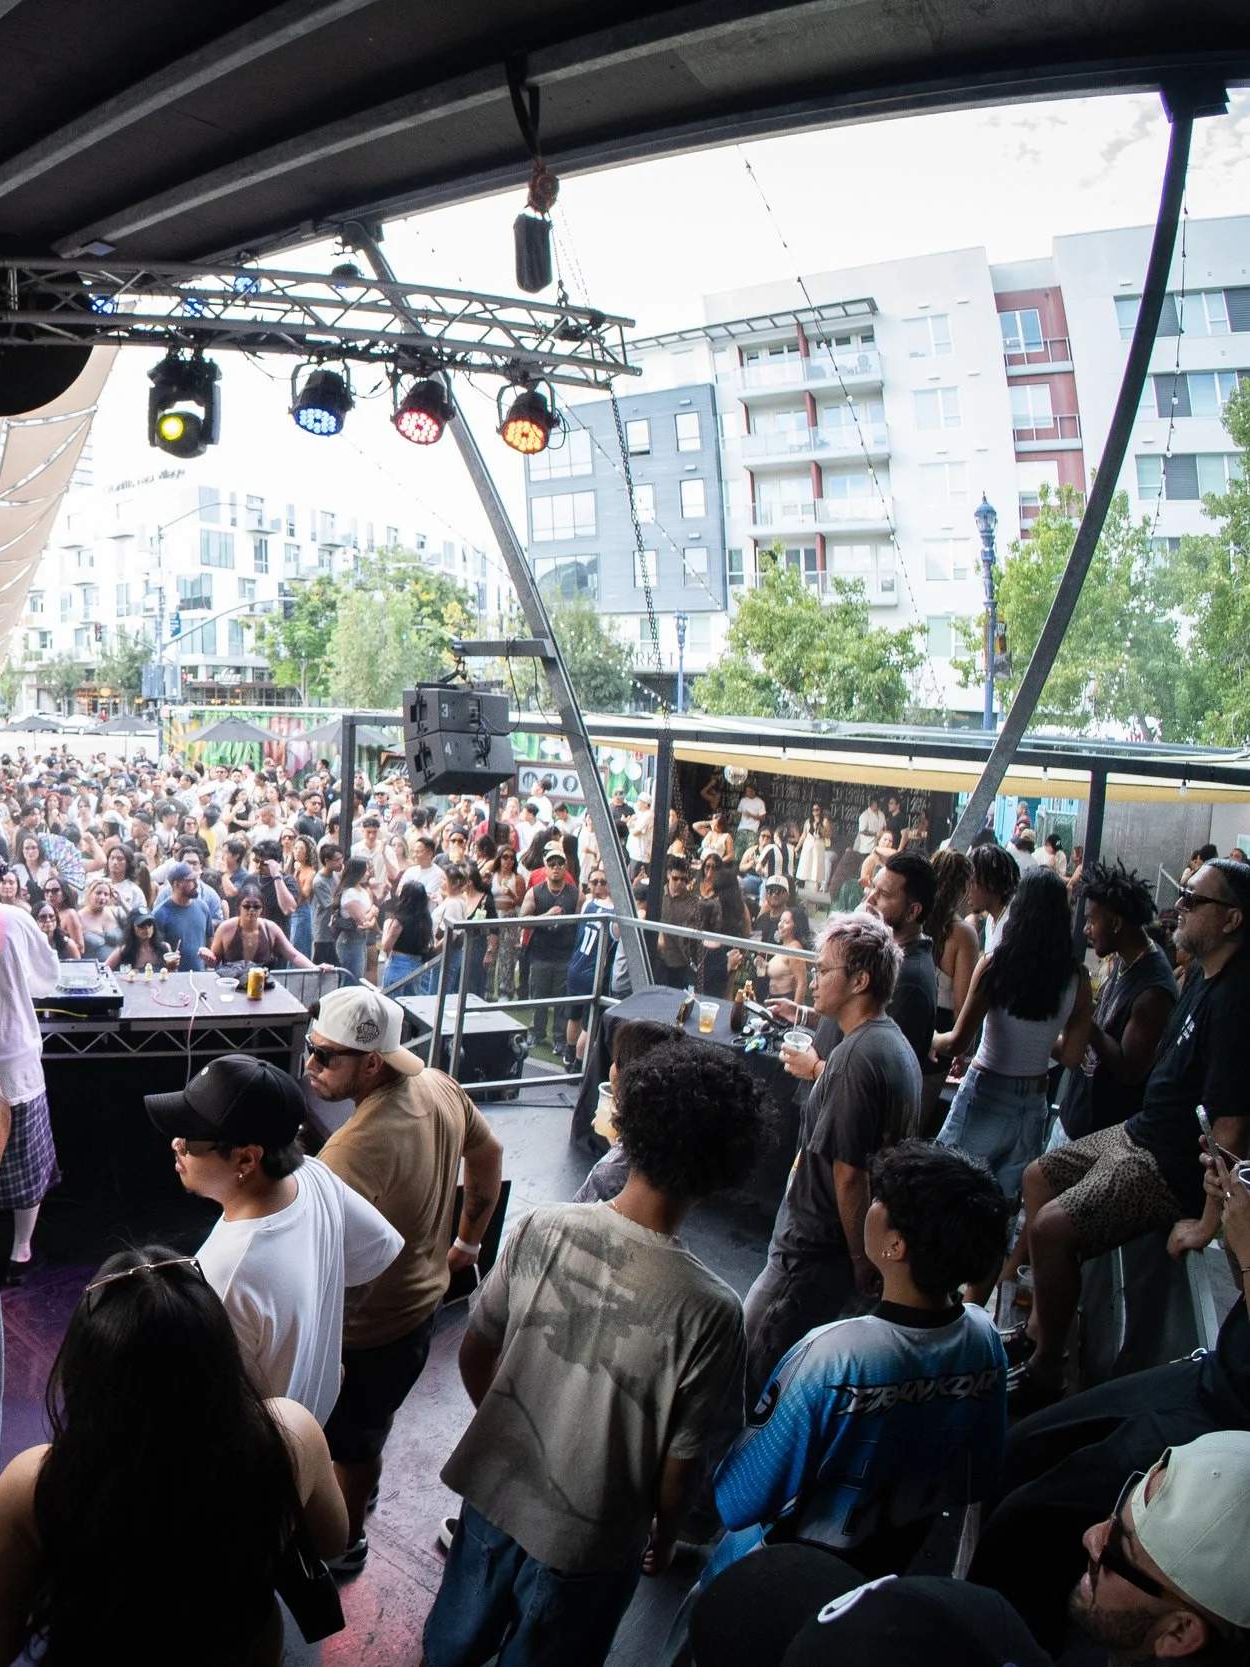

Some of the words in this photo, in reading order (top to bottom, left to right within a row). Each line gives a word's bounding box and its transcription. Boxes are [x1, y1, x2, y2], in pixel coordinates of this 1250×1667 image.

[441, 703, 449, 718] 3
[444, 742, 452, 756] 4
[579, 925, 598, 957] 11
